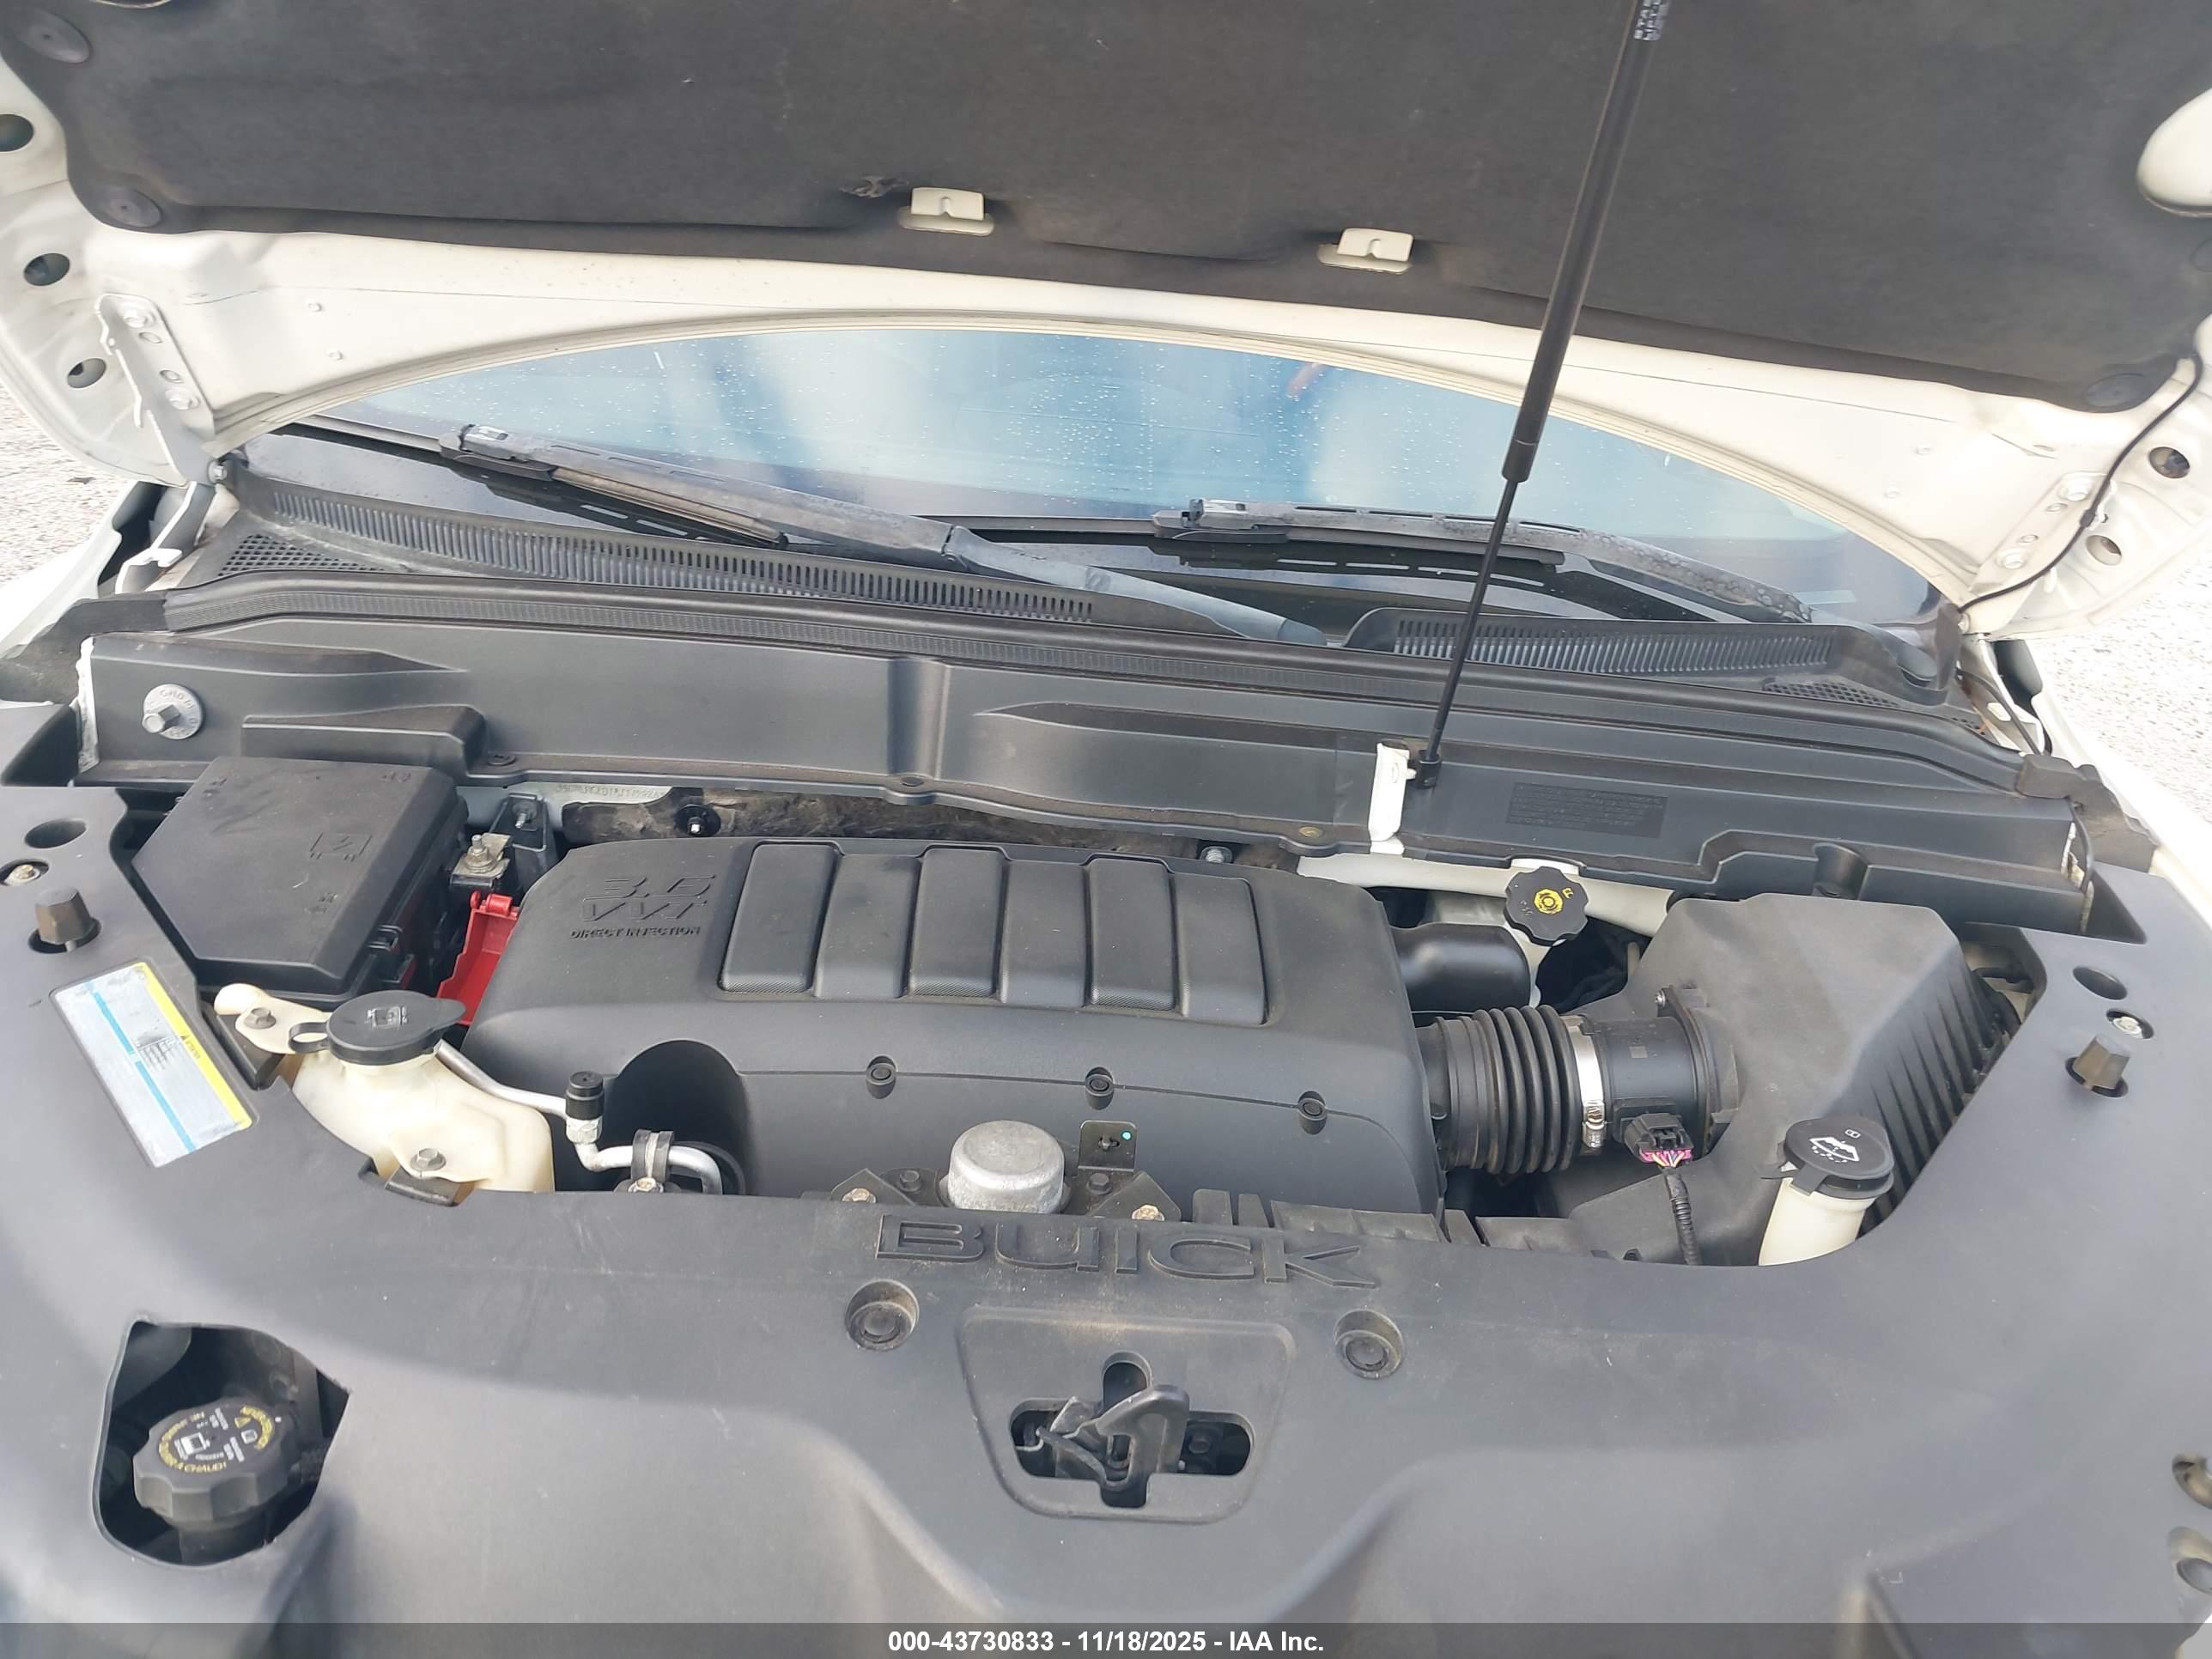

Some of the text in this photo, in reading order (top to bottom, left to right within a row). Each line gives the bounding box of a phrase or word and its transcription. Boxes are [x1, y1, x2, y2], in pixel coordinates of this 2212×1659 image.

[583, 873, 716, 902] 3.6
[582, 901, 708, 921] VVT
[570, 926, 701, 939] DIRECT INJECTION
[876, 1213, 1376, 1287] BUICK
